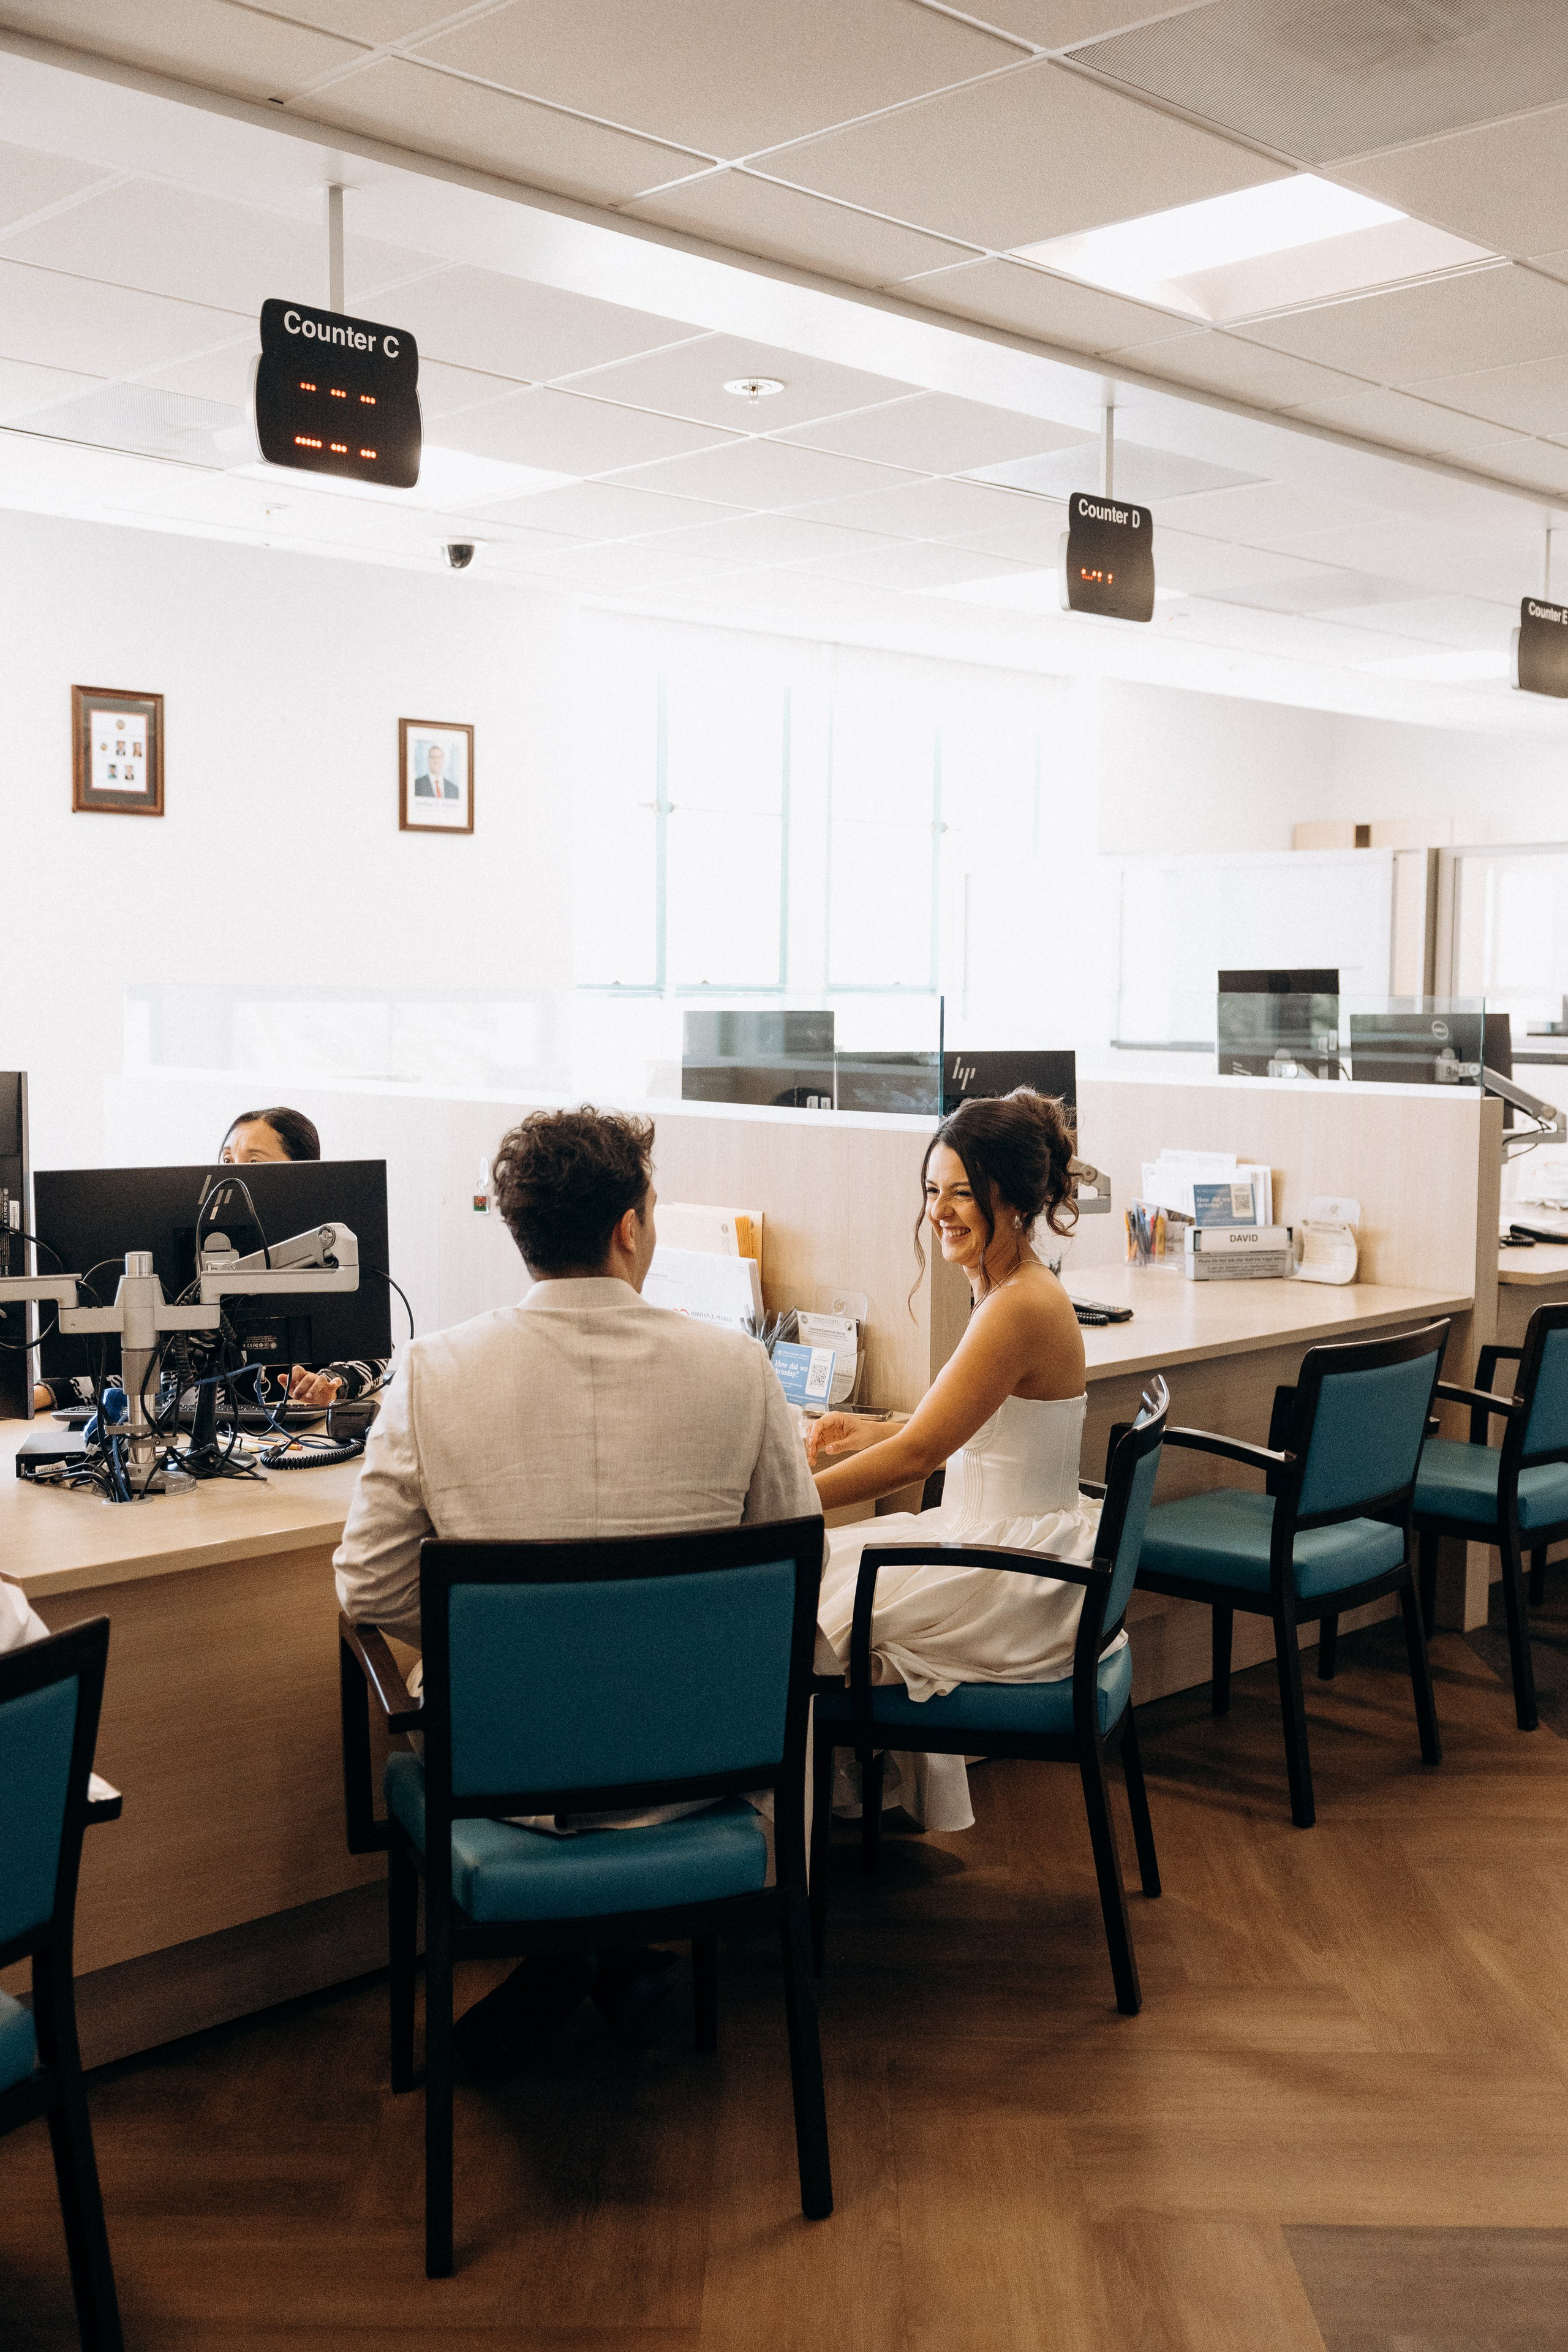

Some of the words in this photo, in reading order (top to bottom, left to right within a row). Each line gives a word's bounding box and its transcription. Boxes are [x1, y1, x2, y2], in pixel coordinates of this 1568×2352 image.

[284, 311, 376, 352] Counter
[383, 336, 399, 358] C
[1079, 499, 1128, 524] Counter
[1132, 510, 1140, 528] D
[1528, 601, 1562, 623] Counter
[1562, 609, 1568, 625] E
[781, 1370, 799, 1378] today?
